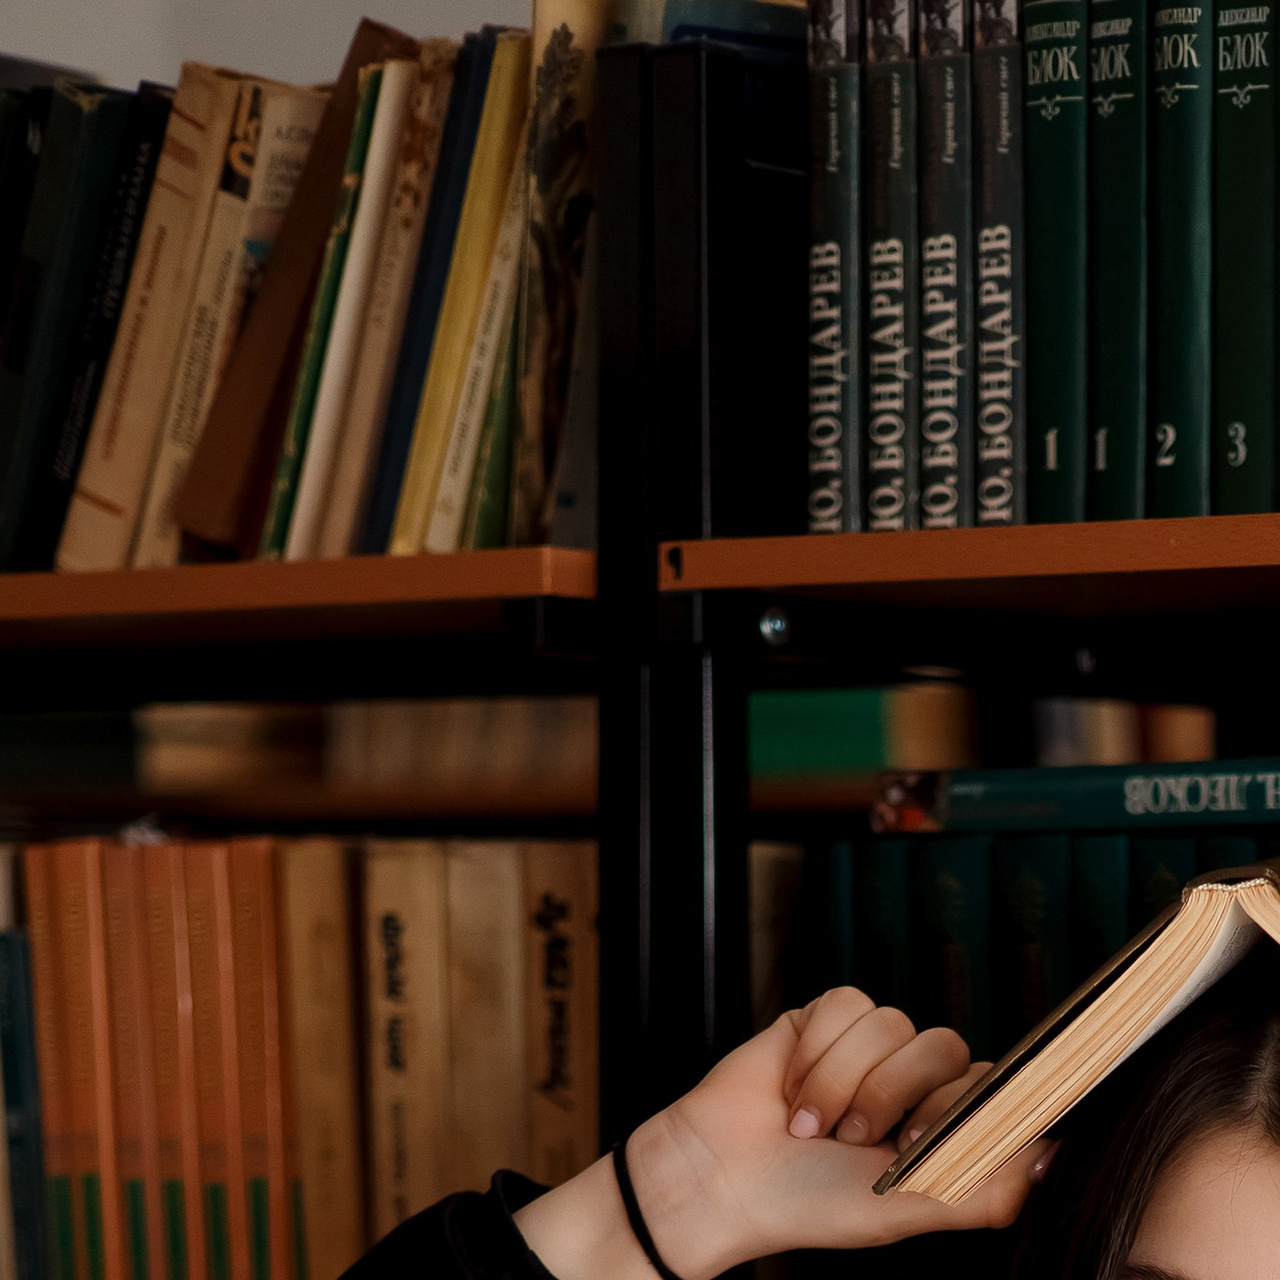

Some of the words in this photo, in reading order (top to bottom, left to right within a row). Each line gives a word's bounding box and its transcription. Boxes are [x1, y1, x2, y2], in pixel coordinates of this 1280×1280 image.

[1027, 45, 1080, 85] БЛОК
[1219, 32, 1269, 71] БЛОК
[808, 241, 849, 472] БОНДАРЕВ
[868, 237, 913, 470] БОНДАРЕВ
[921, 233, 966, 470] БОНДАРЕВ
[977, 224, 1022, 462] БОНДАРЕВ
[1043, 427, 1059, 470] 1
[1094, 427, 1108, 470] 1
[1156, 423, 1178, 467] 2
[1227, 421, 1248, 467] 3
[808, 476, 843, 532] Ю.
[867, 475, 905, 530] Ю.
[921, 474, 959, 530] Ю.
[977, 467, 1013, 523] Ю.
[1123, 773, 1255, 815] ЛЕСКОВ
